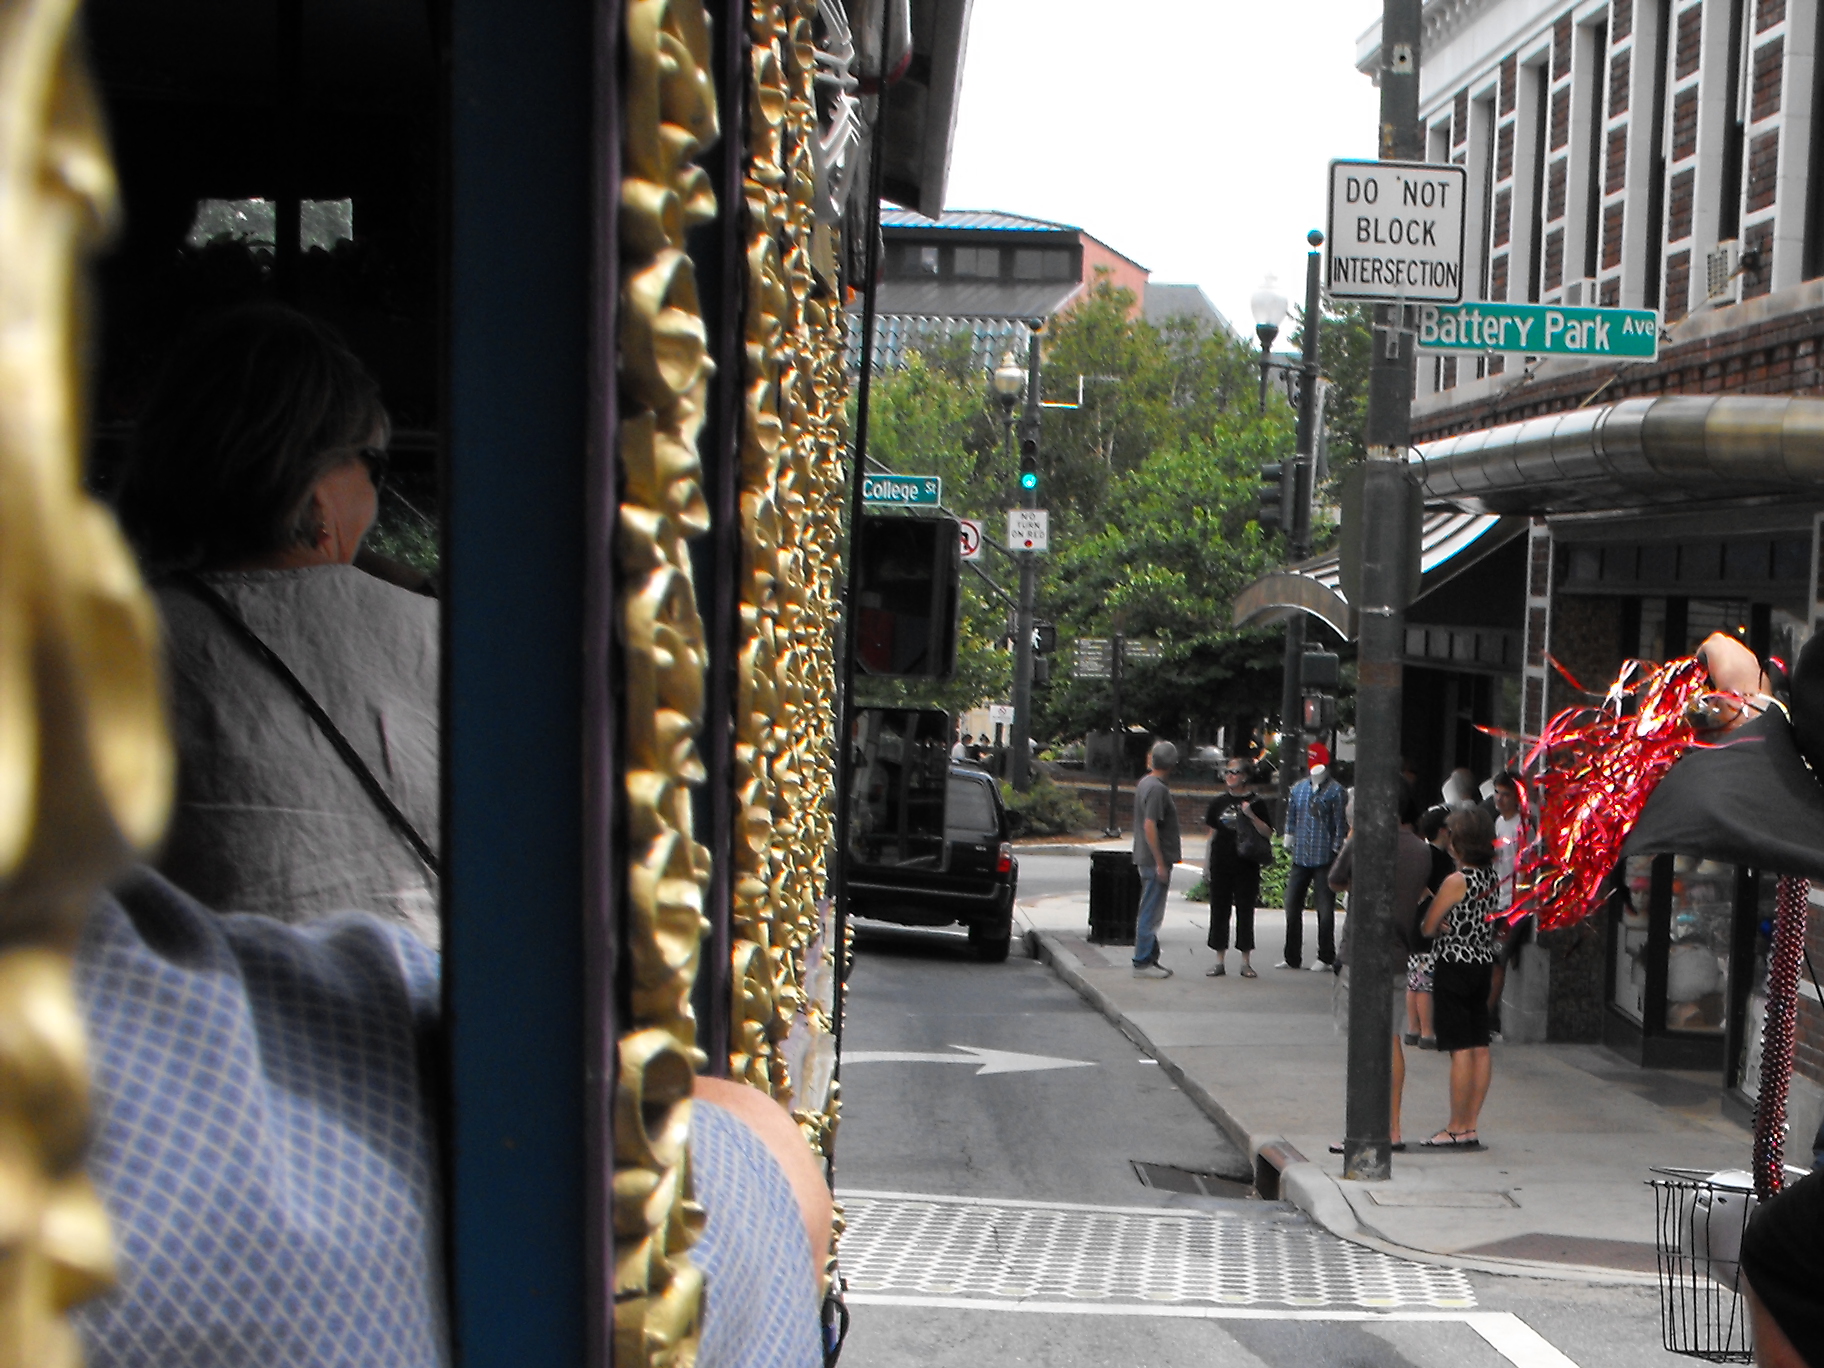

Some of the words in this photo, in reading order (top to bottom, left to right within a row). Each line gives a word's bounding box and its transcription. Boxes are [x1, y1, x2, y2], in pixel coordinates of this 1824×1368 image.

[1346, 178, 1378, 204] DO
[1403, 180, 1450, 207] NOT
[1357, 217, 1436, 246] BLOCK
[1333, 256, 1458, 288] INTERSECTION
[1420, 308, 1534, 347] Battery
[1544, 311, 1611, 351] Park
[1622, 316, 1655, 336] Ave
[863, 479, 920, 503] College
[925, 481, 937, 494] St
[1017, 521, 1040, 529] TURN
[1021, 512, 1036, 520] NO
[1011, 530, 1024, 538] ON
[1027, 531, 1045, 539] RED
